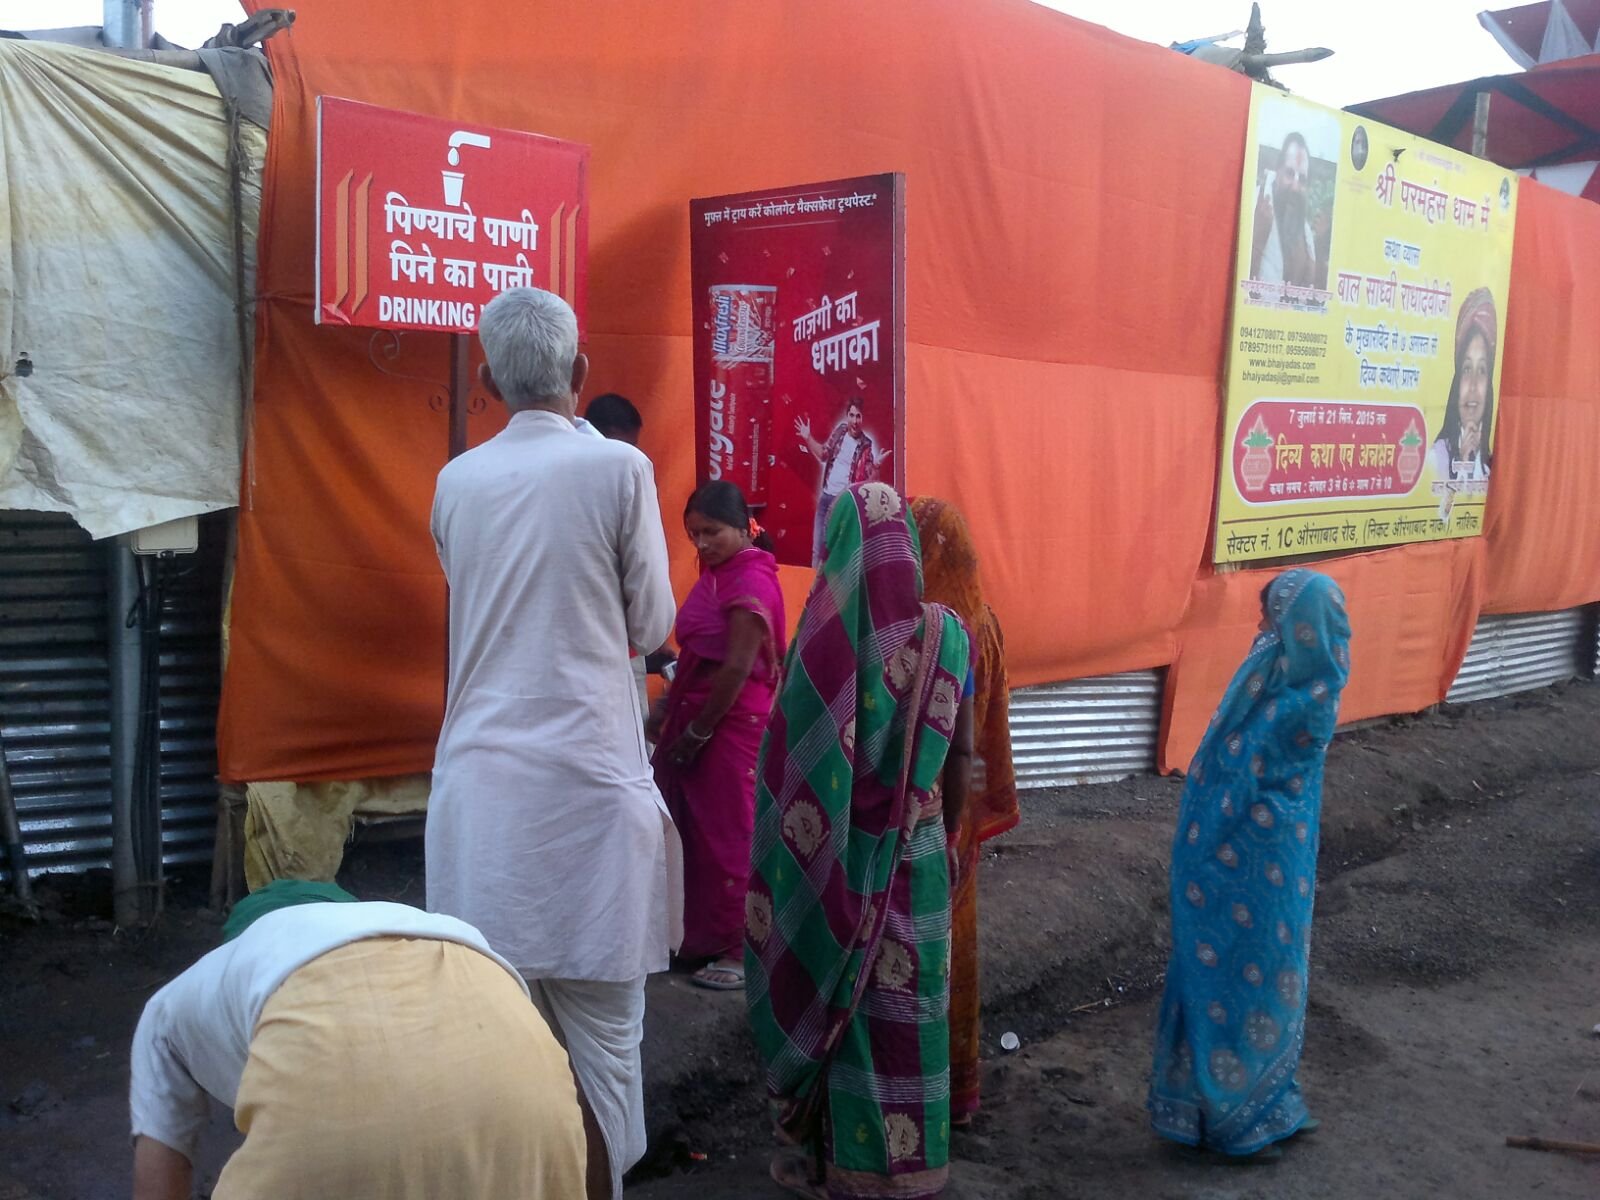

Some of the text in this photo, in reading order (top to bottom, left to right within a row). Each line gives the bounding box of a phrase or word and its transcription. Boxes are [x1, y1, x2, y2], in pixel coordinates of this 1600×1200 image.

[723, 206, 732, 222] में
[731, 209, 747, 224] ट्राय
[748, 203, 762, 220] करें
[763, 200, 795, 217] कोलगेट
[1376, 163, 1396, 206] श्री
[1401, 180, 1449, 224] परमहंस
[1454, 197, 1477, 228] धाम
[1480, 196, 1490, 233] में
[384, 191, 539, 251] पिण्याचे पाणी
[389, 239, 534, 292] पिने का पानी
[1338, 273, 1362, 302] बाल
[1366, 271, 1397, 309] साध्वी
[379, 296, 475, 328] DRINKING
[793, 294, 832, 342] ताज़गी
[834, 291, 858, 323] का
[811, 320, 880, 374] धमाका
[1345, 320, 1354, 345] के
[1249, 358, 1316, 371] www.bhaiyadas.com
[709, 379, 734, 481] olgate
[1289, 409, 1295, 424] 7
[1297, 406, 1316, 428] जुलाई
[1326, 409, 1337, 424] 21
[1356, 411, 1375, 425] 2015
[1275, 432, 1304, 474] दिव्य
[1310, 443, 1335, 469] कथा
[1339, 433, 1355, 472] एवं
[1328, 479, 1334, 492] 3
[1342, 479, 1348, 491] 6
[1370, 478, 1375, 490] 7
[1227, 530, 1257, 555] सेक्टर
[1261, 527, 1271, 551] नं.
[1277, 527, 1294, 549] 1C
[1297, 521, 1339, 546] औरंगाबाद
[1342, 520, 1358, 545] रोड,
[1363, 518, 1389, 544] (निकट
[1392, 515, 1427, 537] औरंगाबाद
